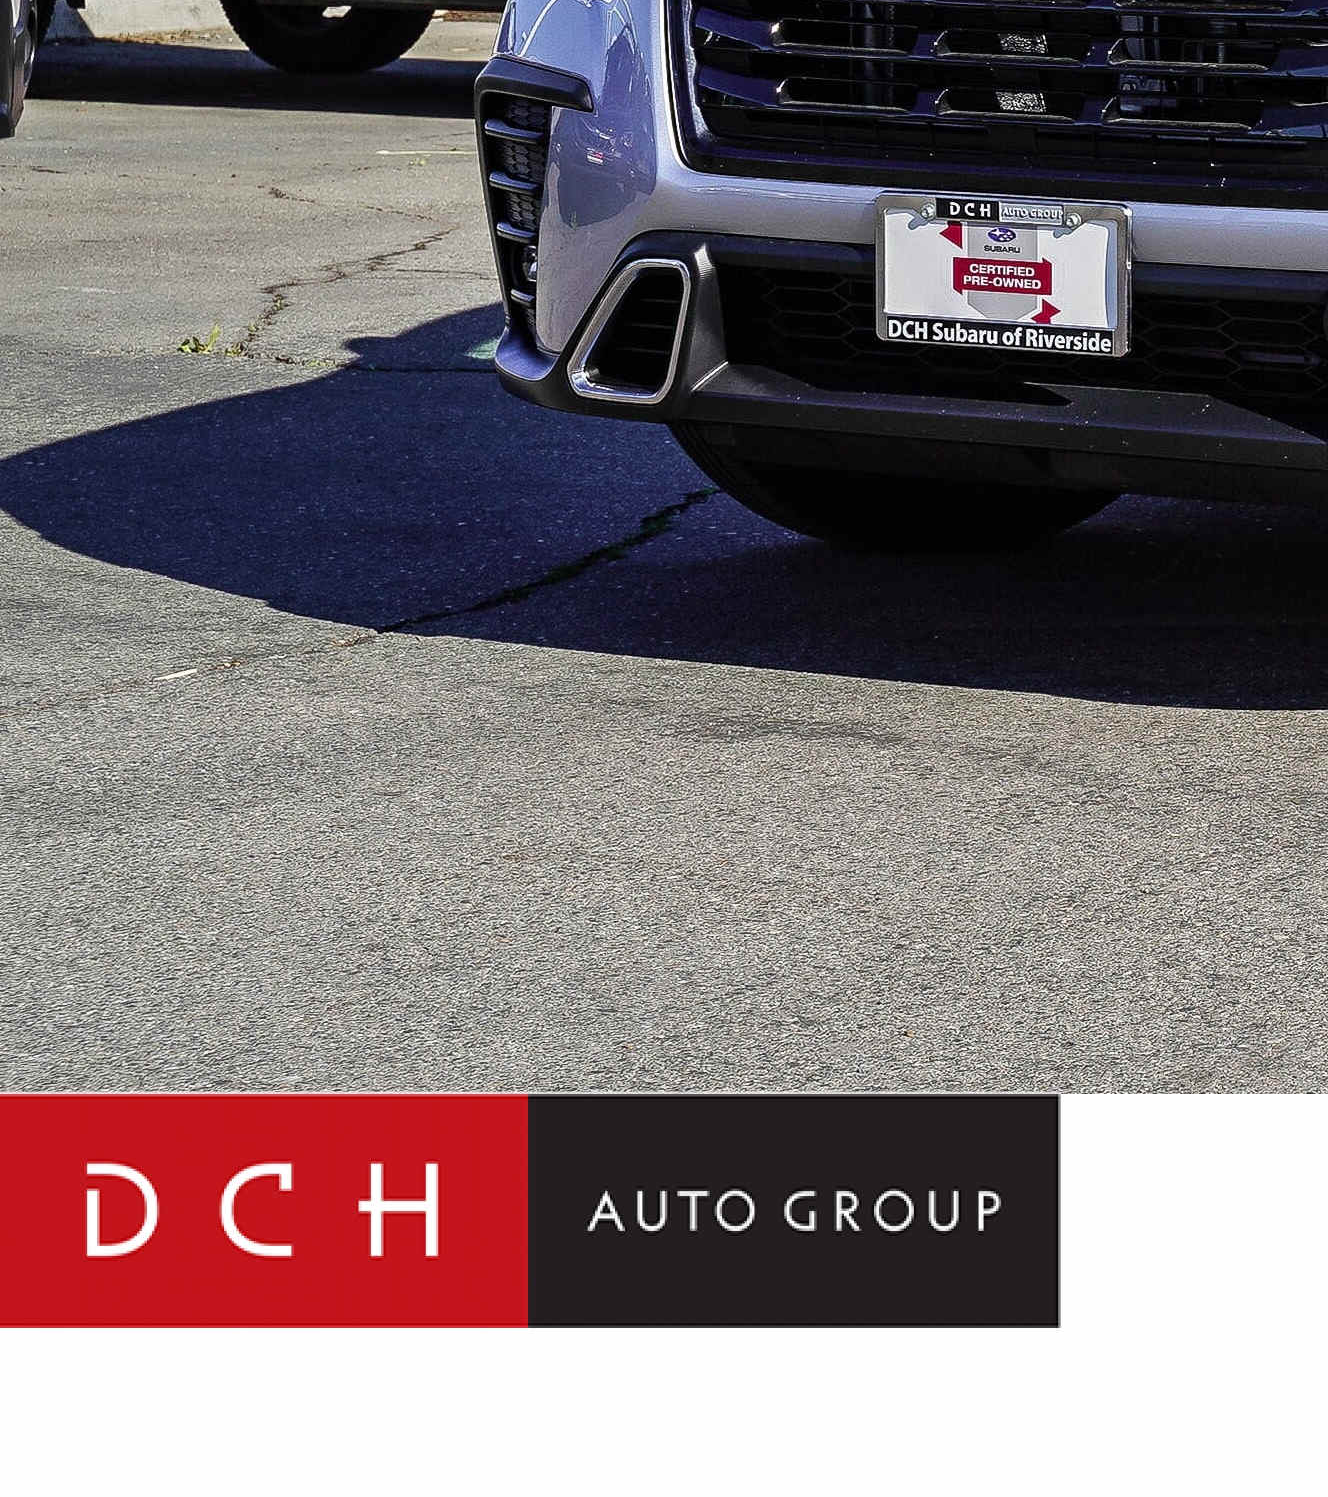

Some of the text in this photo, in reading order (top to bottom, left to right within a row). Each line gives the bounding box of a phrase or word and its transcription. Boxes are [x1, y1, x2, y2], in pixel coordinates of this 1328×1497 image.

[949, 201, 991, 218] DCH
[1002, 206, 1064, 219] AUTO GROUP
[984, 245, 1020, 253] SUBARU
[969, 263, 1035, 277] CERTIFIED
[963, 275, 1042, 289] PRE-OWNED
[888, 319, 1112, 352] DCH Subaru of Riverside
